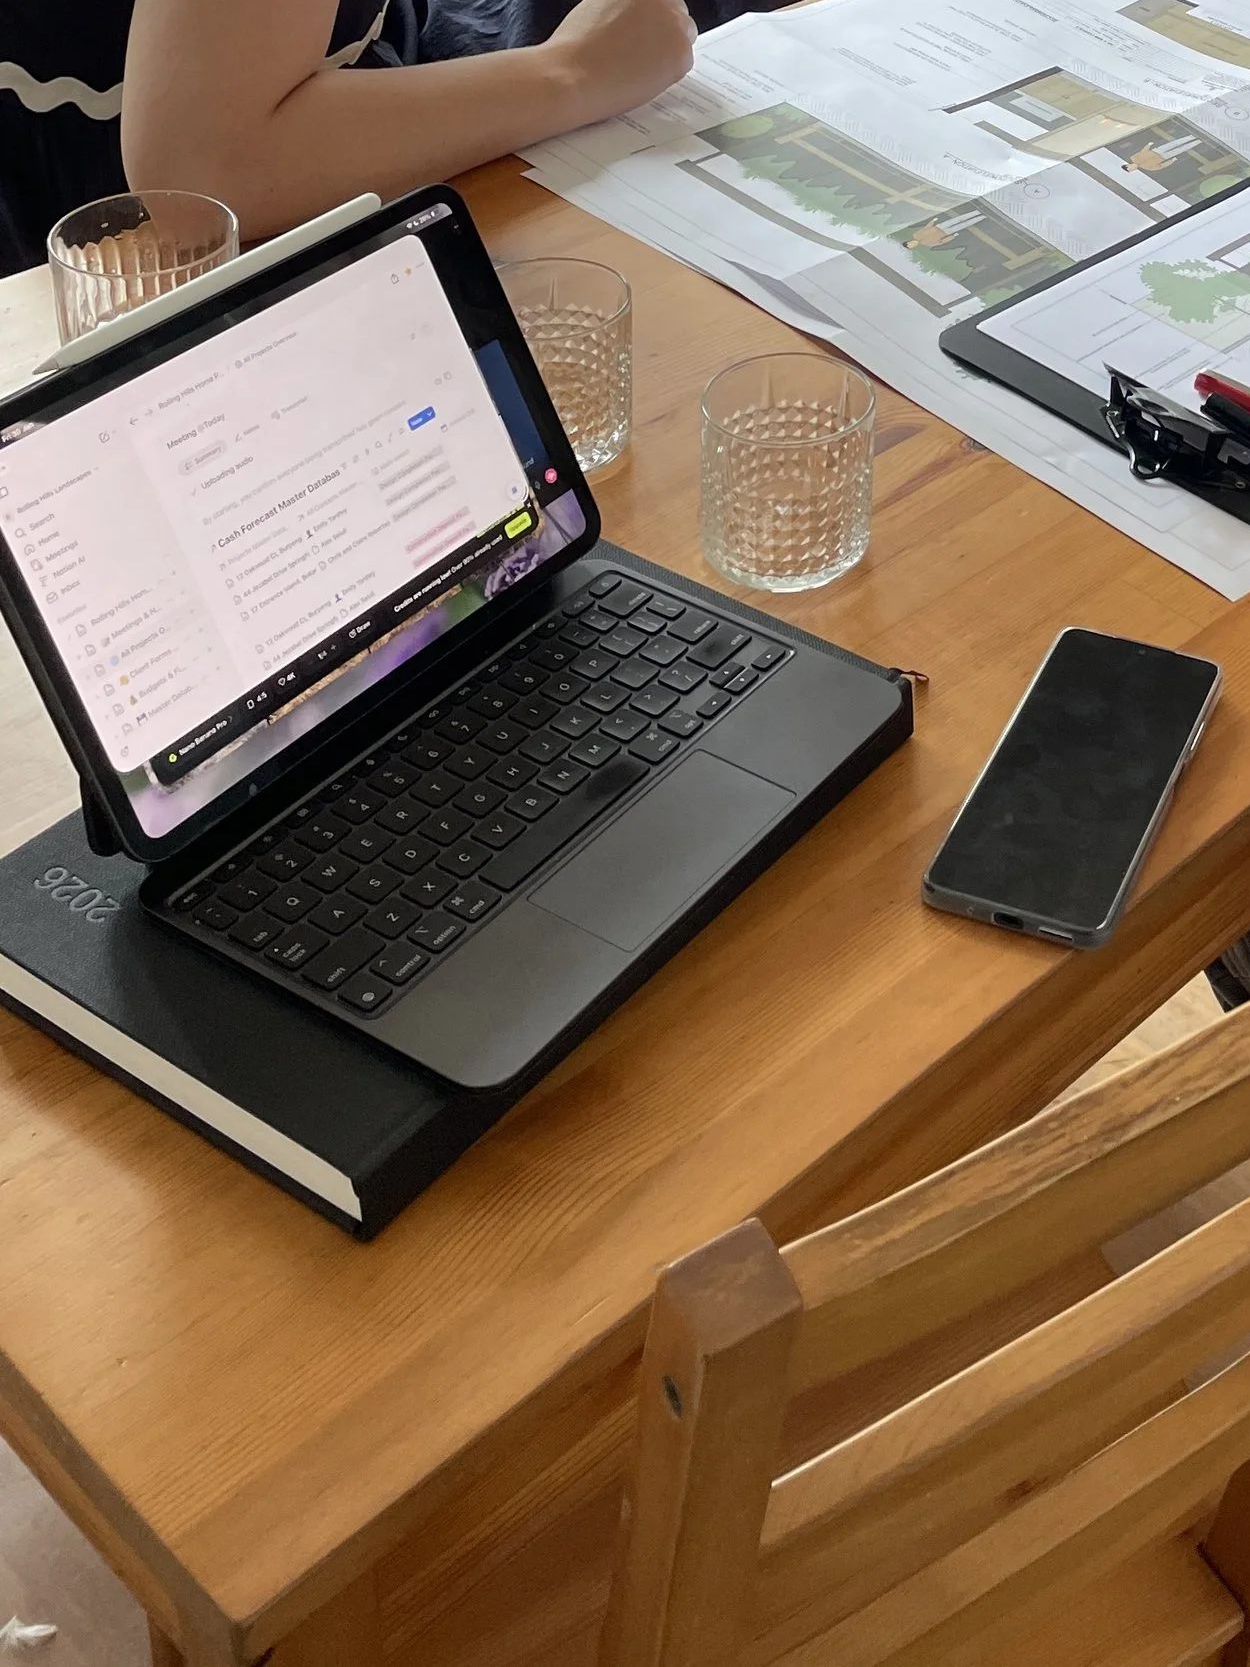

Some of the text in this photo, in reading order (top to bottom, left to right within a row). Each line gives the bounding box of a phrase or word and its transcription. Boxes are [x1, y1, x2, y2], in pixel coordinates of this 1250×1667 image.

[166, 429, 197, 449] Meeting
[200, 456, 253, 489] Uploading audio
[217, 530, 240, 547] Cash
[240, 506, 277, 533] Forecast
[277, 489, 306, 510] Master
[306, 469, 340, 492] Databas
[29, 513, 55, 530] Search
[37, 530, 59, 546] Home
[45, 540, 78, 561] Meetings
[52, 561, 77, 578] Notion
[60, 580, 80, 594] Inbox
[393, 597, 413, 612] Credits
[589, 745, 600, 754] M
[558, 771, 569, 779] N
[405, 850, 416, 858] D
[322, 866, 336, 876] W
[34, 866, 121, 922] 2026
[423, 882, 435, 891] X
[469, 900, 486, 914] cmd
[387, 913, 398, 921] Z
[253, 931, 268, 942] tab
[433, 925, 456, 944] option
[283, 942, 301, 958] caps
[289, 949, 307, 962] lock
[396, 954, 421, 977] control
[327, 967, 346, 982] shift
